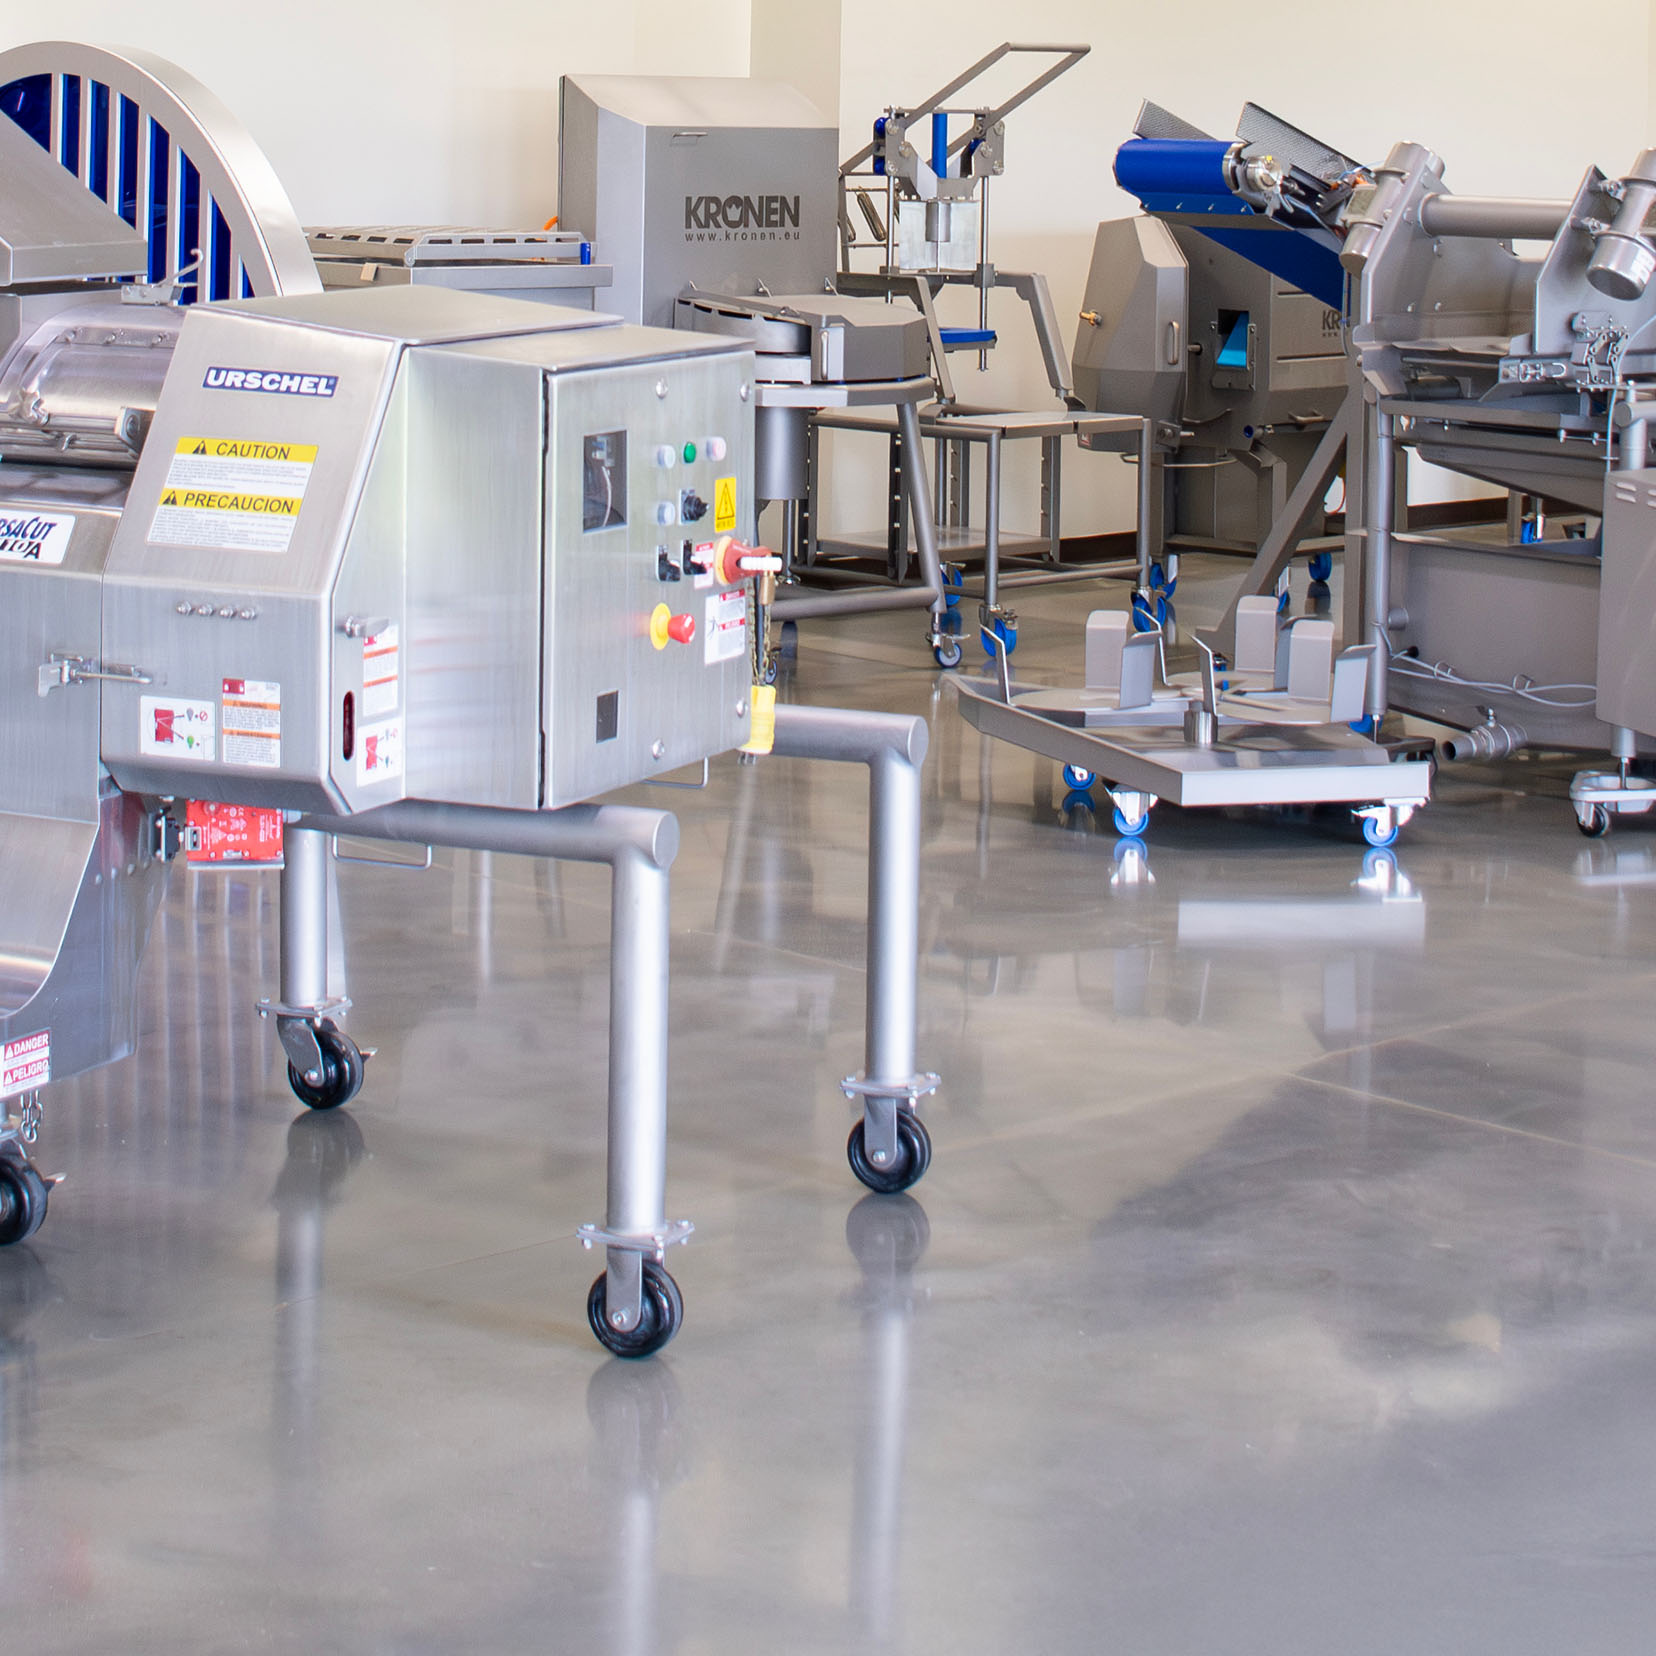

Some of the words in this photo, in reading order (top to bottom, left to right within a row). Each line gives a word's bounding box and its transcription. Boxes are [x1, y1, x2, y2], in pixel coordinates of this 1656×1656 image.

[685, 195, 800, 229] KRONEN
[685, 230, 800, 242] www.kronen.eu
[206, 369, 333, 395] URSCHEL
[216, 442, 291, 460] CAUTION
[184, 493, 294, 513] PRECAUCION
[14, 1033, 49, 1056] DANGER
[13, 1059, 49, 1081] PELIGRO
